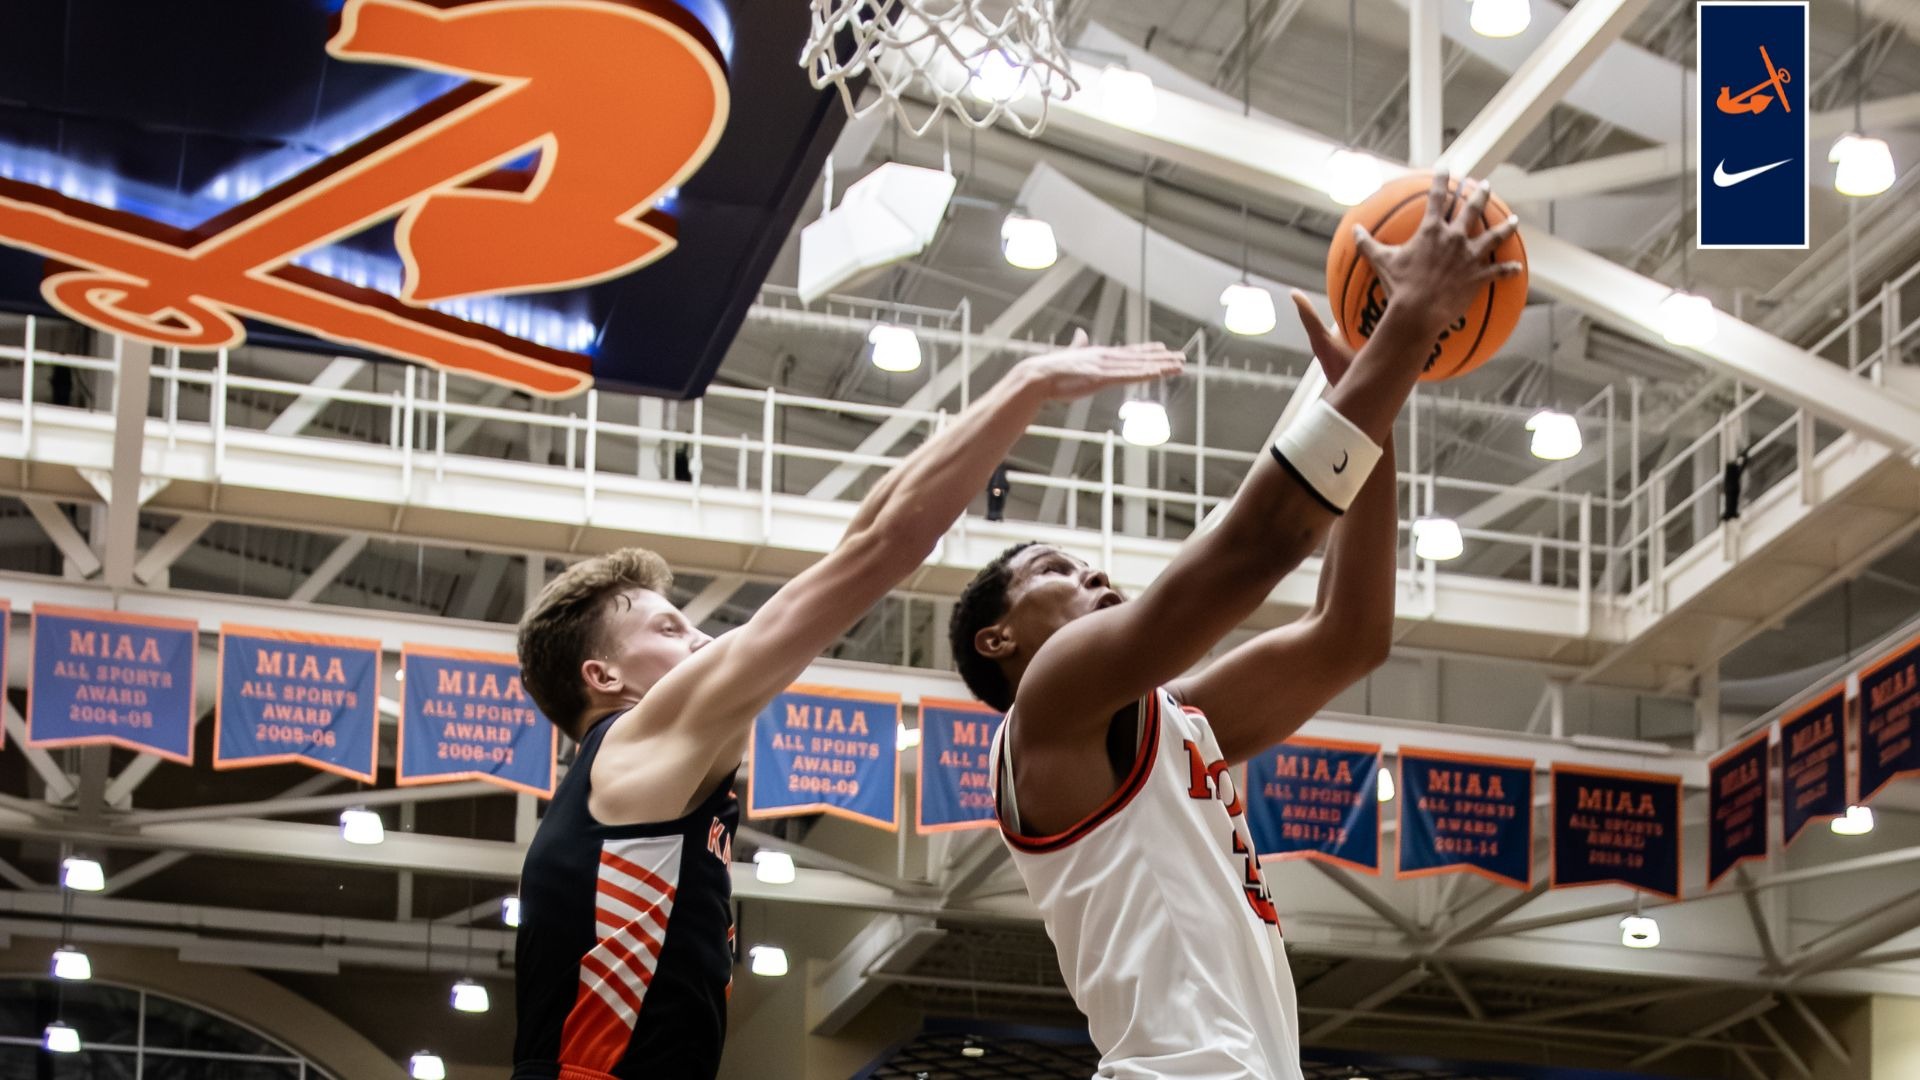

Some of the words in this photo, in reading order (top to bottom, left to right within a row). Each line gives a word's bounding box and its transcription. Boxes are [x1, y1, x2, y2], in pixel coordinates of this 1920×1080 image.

[70, 629, 161, 664] MIAA
[54, 660, 90, 680] ALL
[97, 665, 172, 688] SPORTS
[256, 649, 346, 684] MIAA
[76, 684, 147, 706] AWARD
[241, 681, 276, 700] ALL
[283, 685, 357, 709] SPORTS
[438, 668, 525, 702] MIAA
[263, 703, 331, 726] AWARD
[423, 699, 457, 719] ALL
[464, 703, 536, 727] SPORTS
[786, 703, 869, 736] MIAA
[256, 723, 336, 748] 2005-06
[444, 722, 512, 744] AWARD
[772, 733, 804, 752] ALL
[811, 737, 879, 760] SPORTS
[953, 720, 989, 747] MI
[792, 755, 856, 776] AWARD
[940, 750, 971, 768] ALL
[1276, 753, 1352, 785] MIAA
[1264, 783, 1293, 800] ALL
[1428, 768, 1505, 799] MIAA
[1282, 804, 1341, 824] AWARD
[1418, 796, 1449, 812] ALL
[1578, 786, 1656, 817] MIAA
[1436, 817, 1498, 836] AWARD
